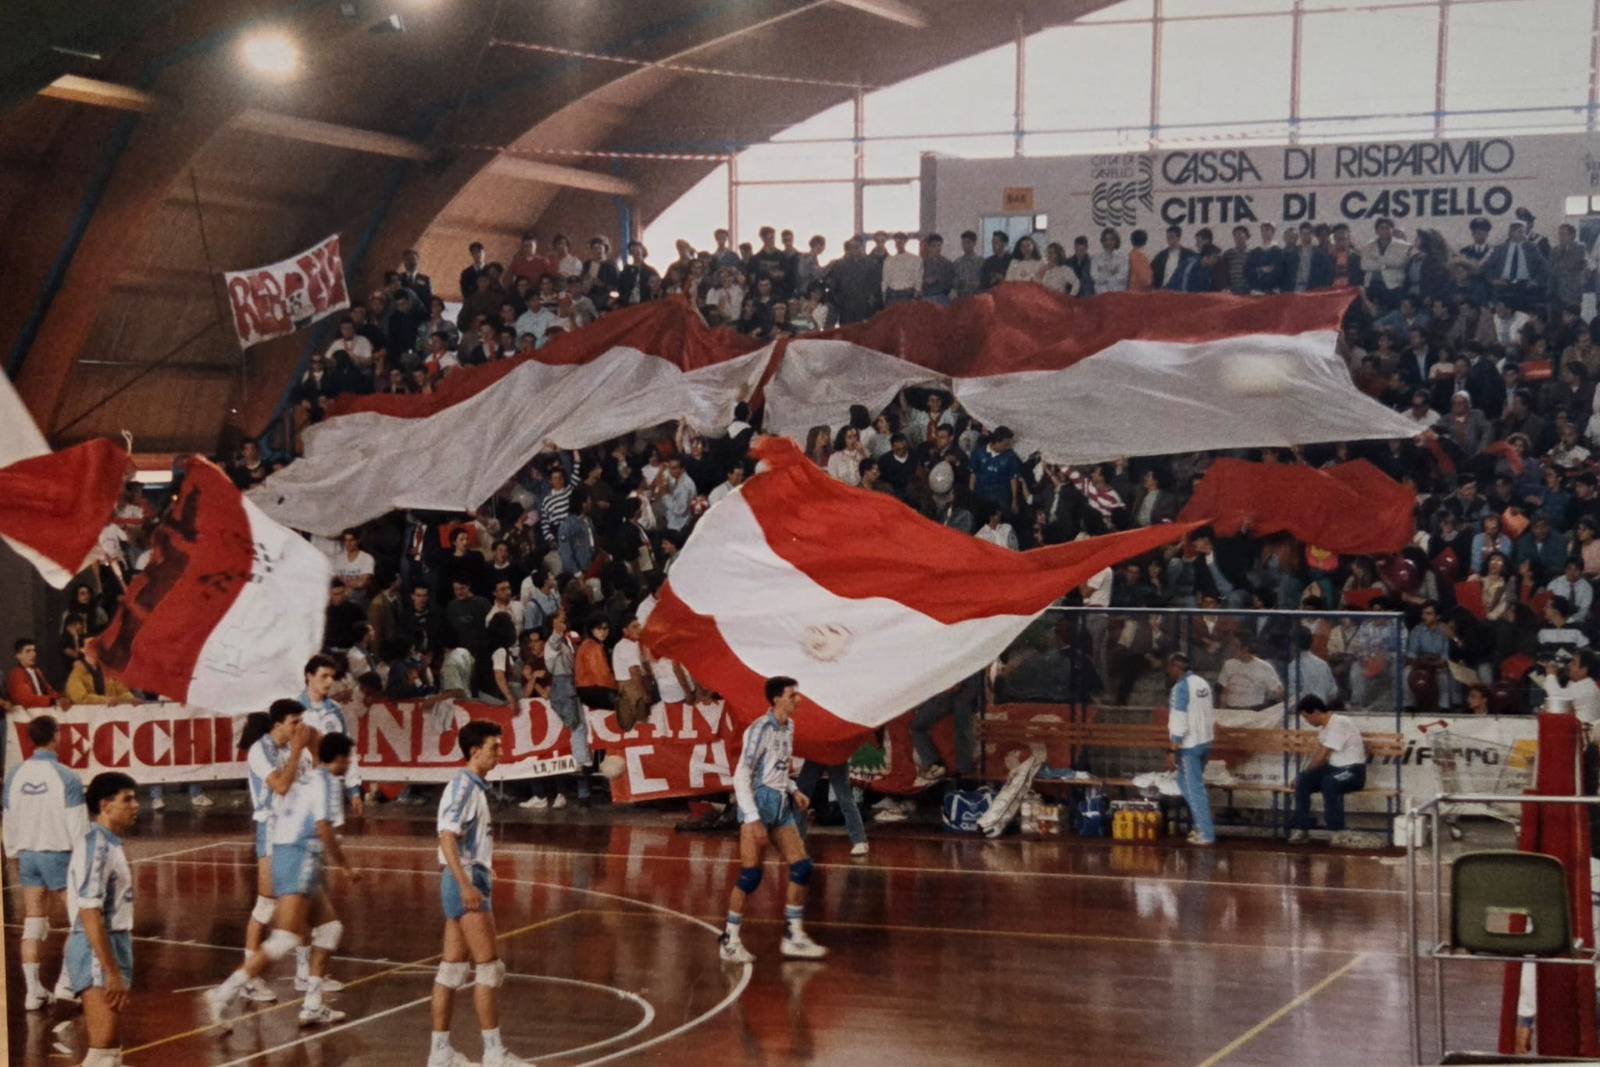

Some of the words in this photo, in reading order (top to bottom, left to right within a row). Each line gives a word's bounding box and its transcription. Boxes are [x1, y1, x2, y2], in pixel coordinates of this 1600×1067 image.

[1161, 149, 1263, 185] CASSA
[1283, 147, 1316, 181] DI
[1335, 138, 1515, 179] RISPARMIO
[1282, 191, 1317, 221] DI
[1339, 185, 1514, 220] CASTELLO
